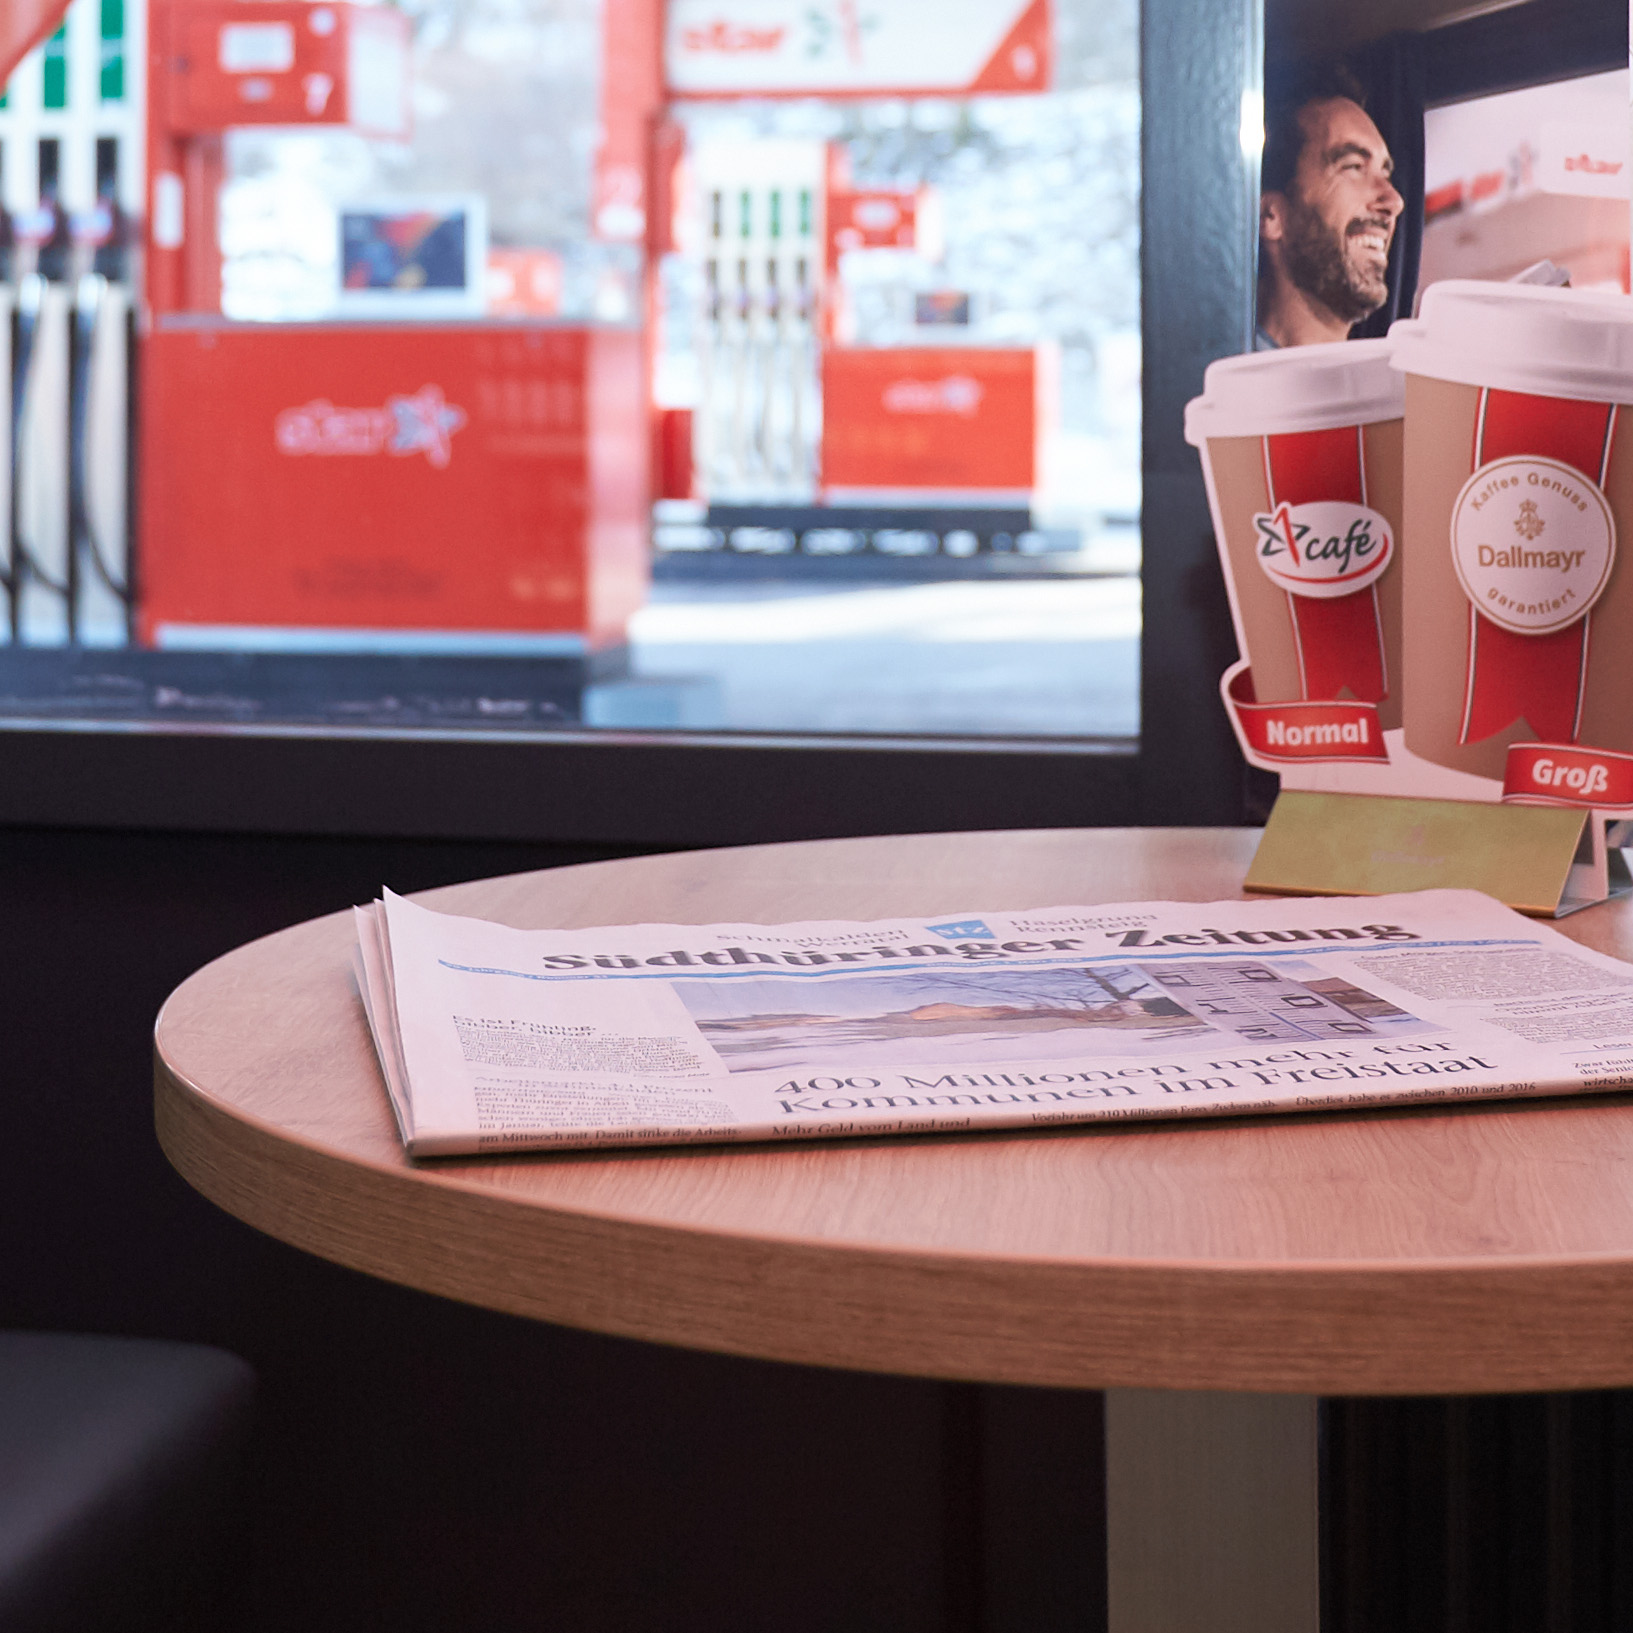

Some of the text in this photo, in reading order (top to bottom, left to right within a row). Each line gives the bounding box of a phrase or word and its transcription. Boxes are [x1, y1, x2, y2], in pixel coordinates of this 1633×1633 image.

[1471, 472, 1588, 513] Kaffee Genuss
[1305, 519, 1377, 574] café
[1478, 545, 1586, 573] Dallmayr
[1487, 587, 1576, 615] garantiert
[1266, 717, 1369, 746] Normal
[1532, 758, 1609, 795] Groß
[1010, 914, 1158, 926] Haselgrund
[1016, 921, 1148, 933] Rennsteig
[542, 938, 1084, 970] Südthüringer
[1105, 924, 1422, 947] Zeitung
[716, 929, 906, 944] Schmalkalden
[797, 934, 909, 948] Werratal
[774, 1040, 1459, 1093] 400 Millionen mehr für
[778, 1055, 1500, 1113] Kommunen im Freistaat
[1450, 1085, 1478, 1095] 2010
[1481, 1083, 1505, 1093] und
[479, 1135, 499, 1143] am
[503, 1131, 562, 1143] Mittwoch
[595, 1130, 634, 1140] Damit
[672, 1128, 692, 1137] die
[771, 1117, 971, 1136] Mehr Geld vom Land und
